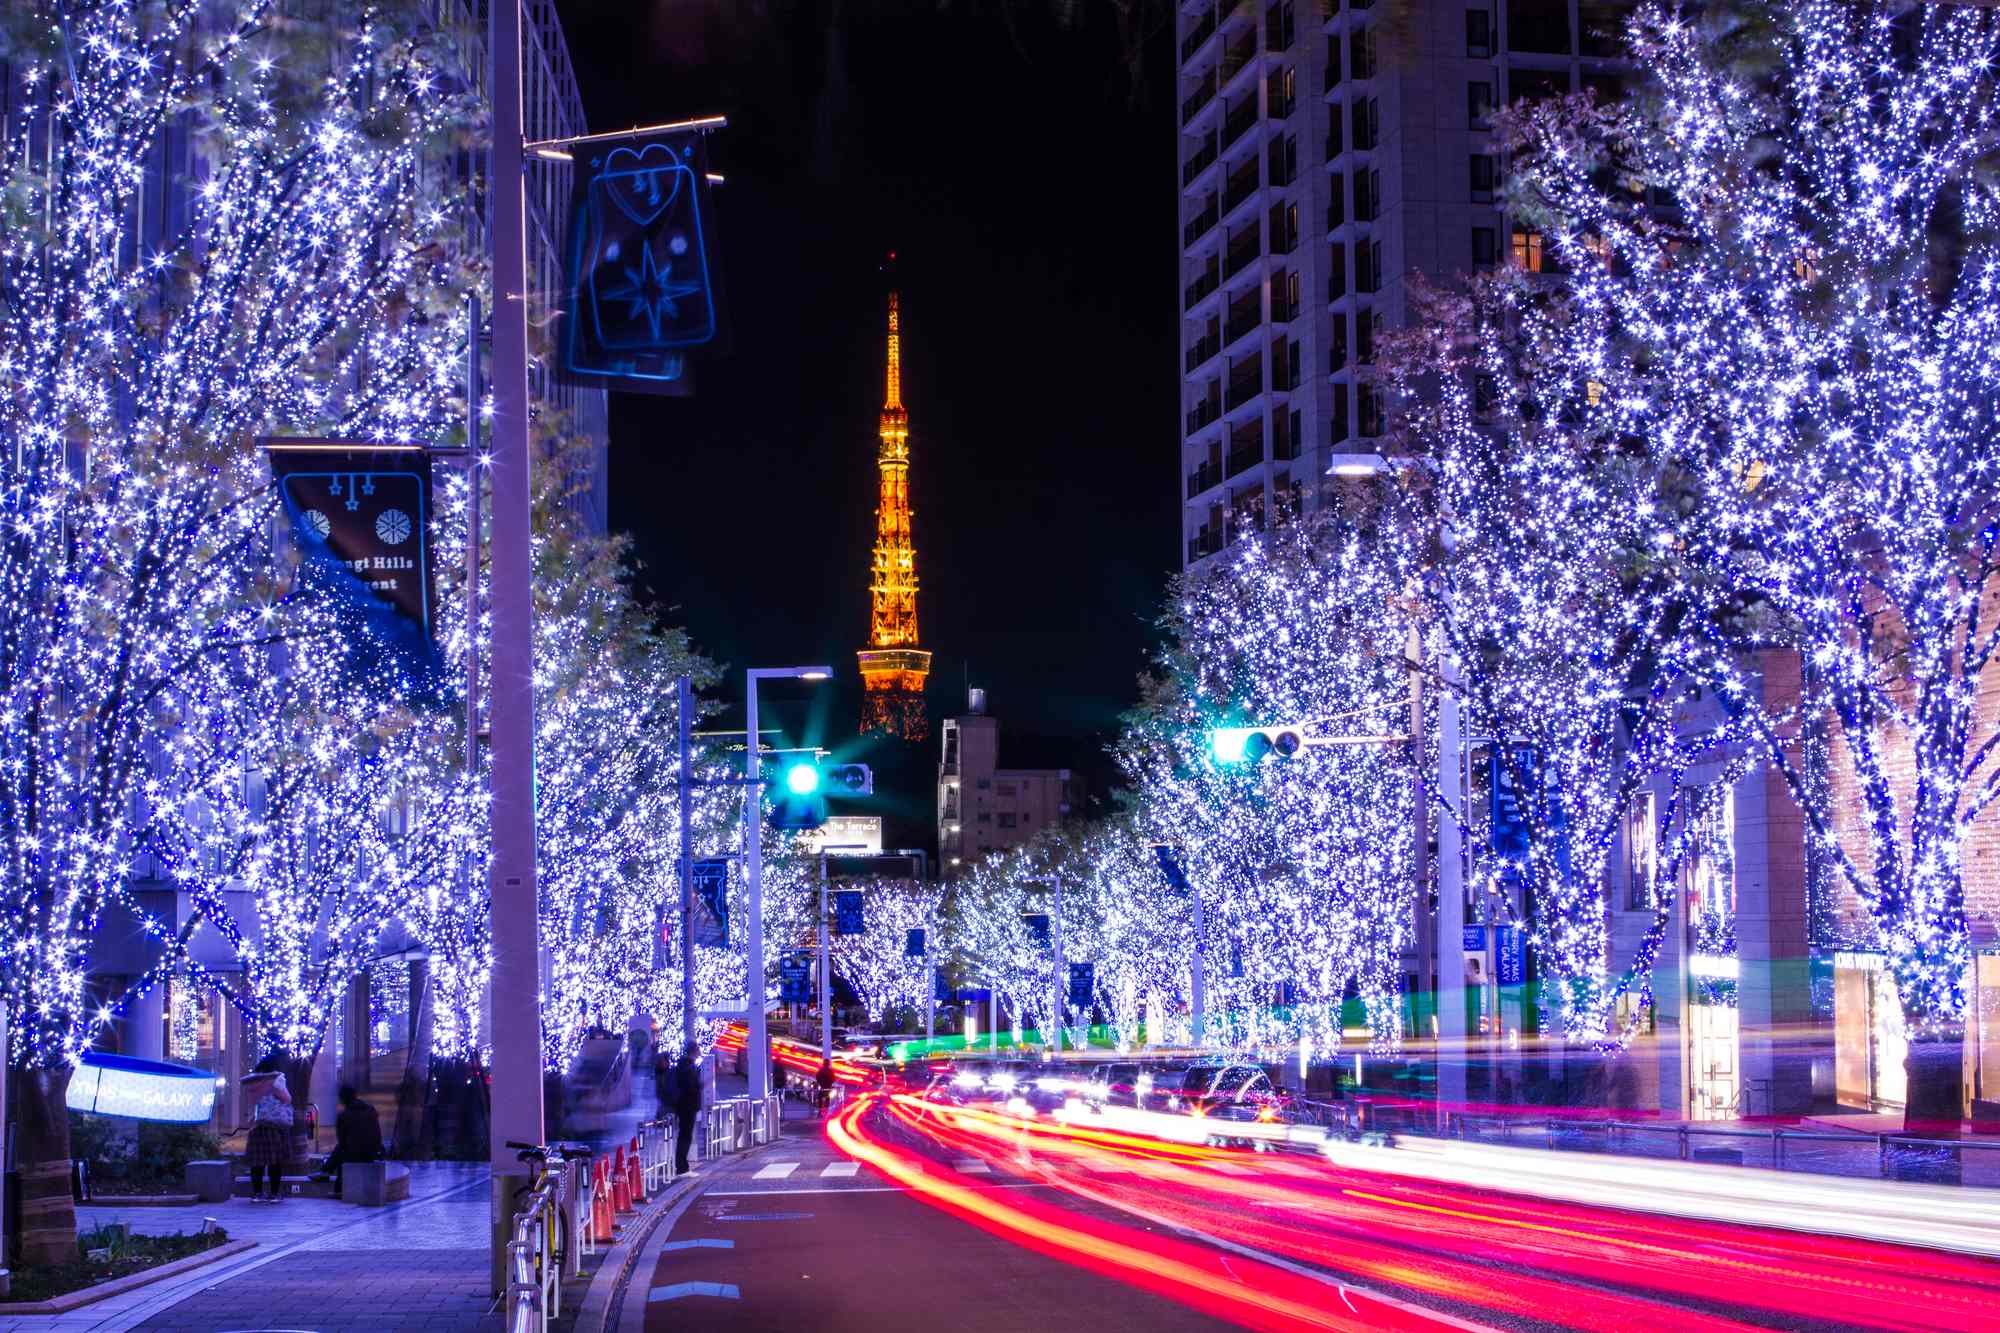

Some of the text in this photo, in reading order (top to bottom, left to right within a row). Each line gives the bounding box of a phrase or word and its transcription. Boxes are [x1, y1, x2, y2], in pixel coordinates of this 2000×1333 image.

[373, 556, 413, 569] Hills
[1511, 928, 1520, 955] ERRY
[1501, 946, 1511, 981] GALAXY
[143, 1088, 193, 1107] GALAXY
